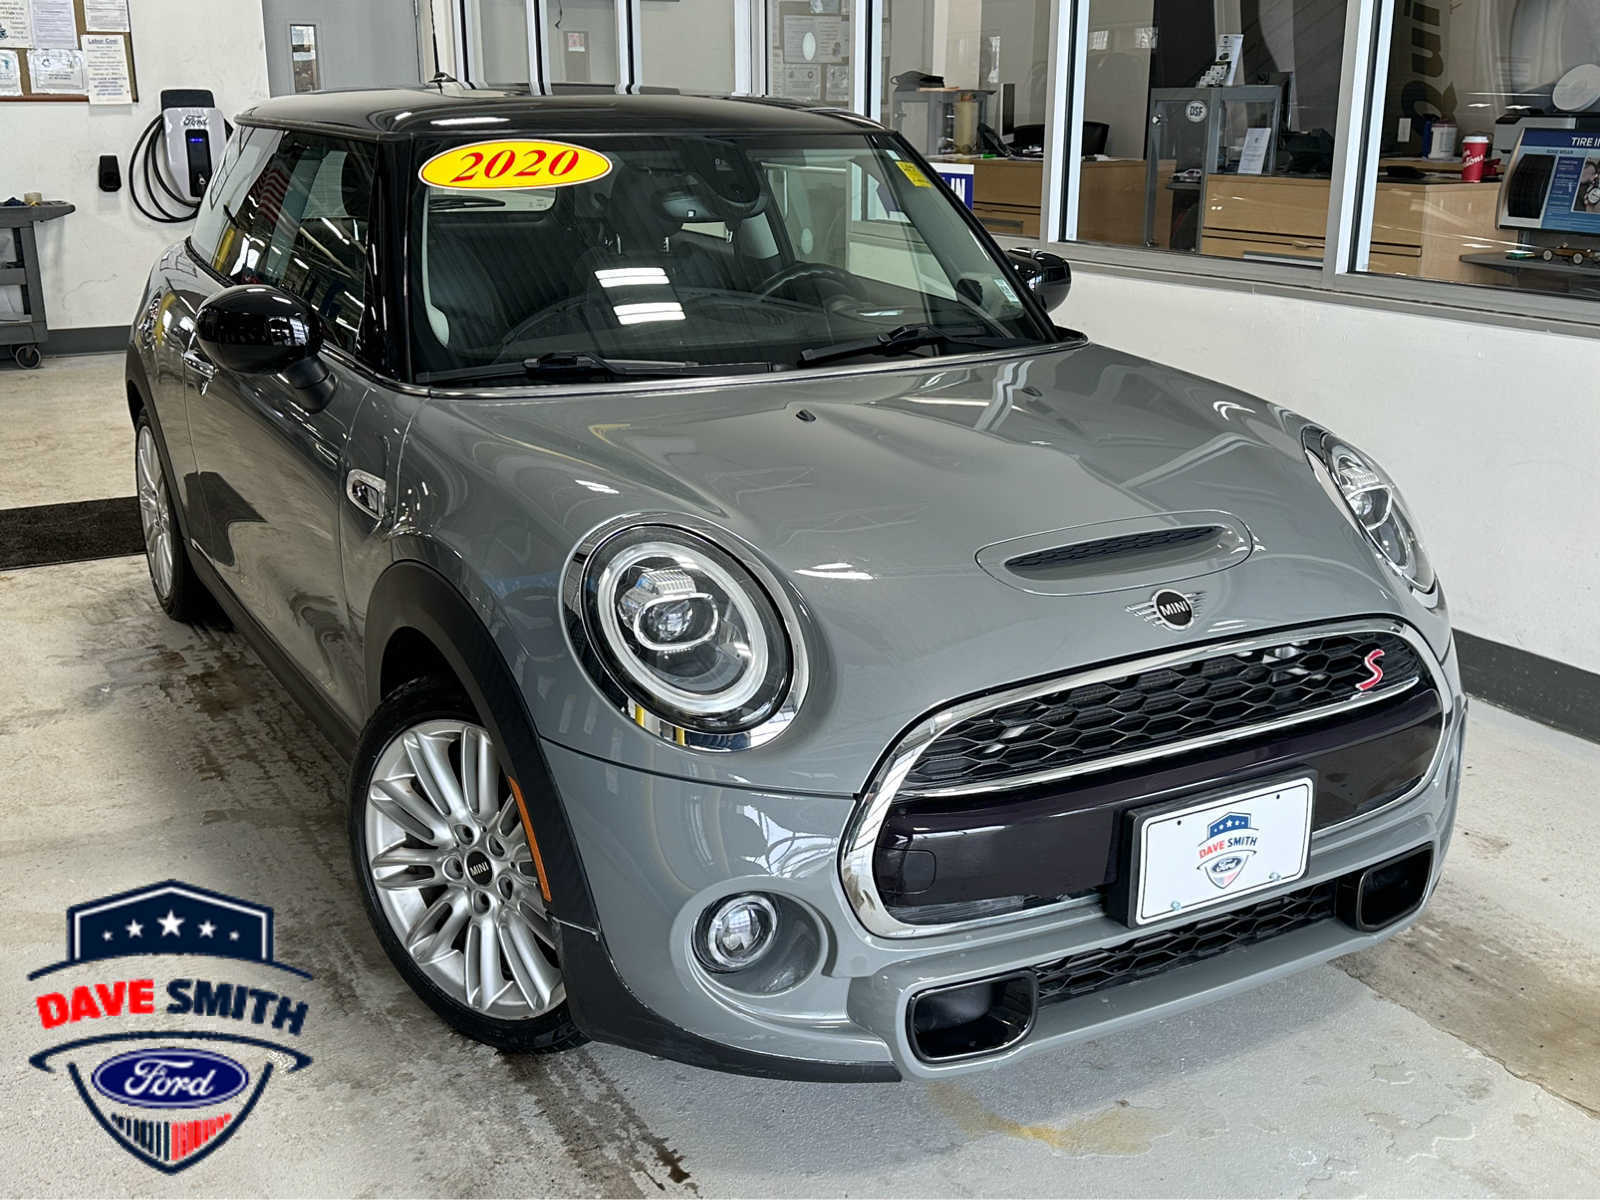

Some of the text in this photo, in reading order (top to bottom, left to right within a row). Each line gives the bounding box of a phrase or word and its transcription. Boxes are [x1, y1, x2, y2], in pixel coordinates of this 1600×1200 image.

[1190, 106, 1203, 117] DSF
[183, 115, 209, 126] Ford
[1571, 137, 1593, 147] TIRE
[450, 150, 579, 183] 2020
[1158, 601, 1191, 618] MINI
[1356, 648, 1385, 691] S
[1199, 836, 1258, 859] DAVE SMITH
[469, 861, 489, 877] MINI
